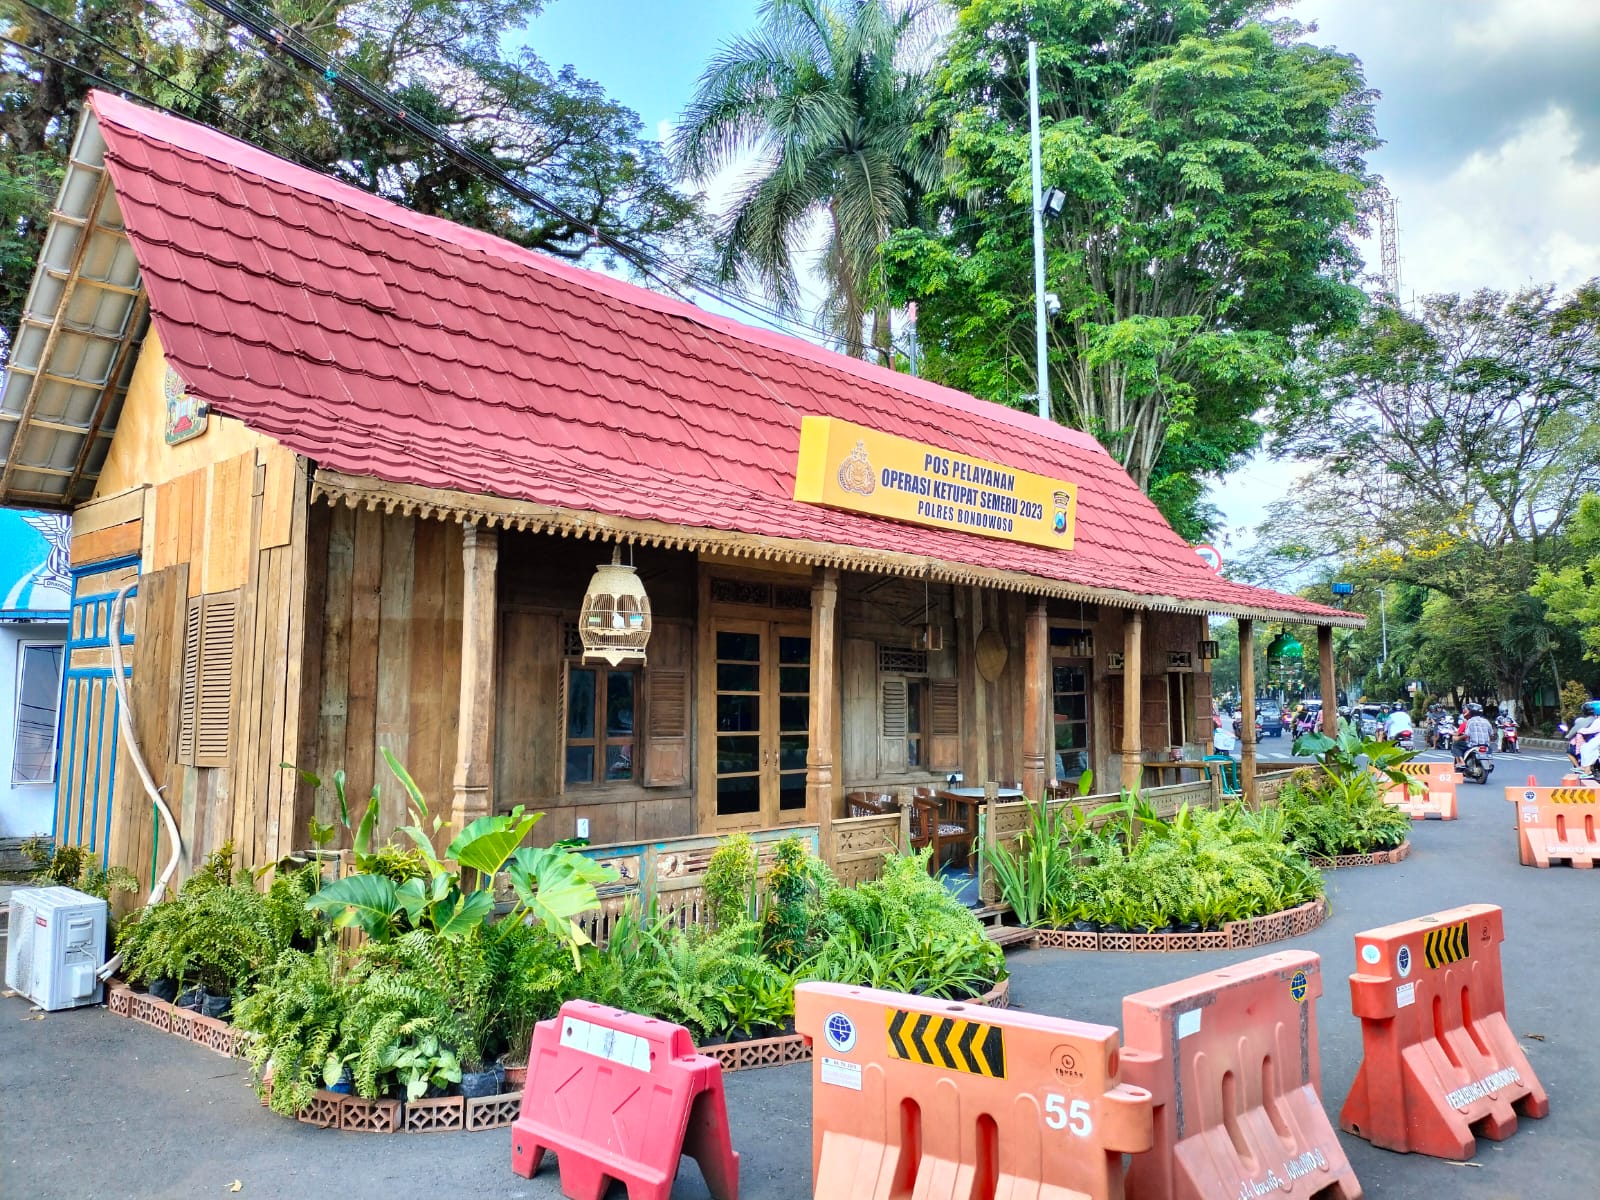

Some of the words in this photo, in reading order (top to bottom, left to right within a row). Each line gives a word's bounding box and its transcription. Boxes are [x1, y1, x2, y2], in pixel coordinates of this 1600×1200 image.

[924, 453, 949, 477] POS
[952, 462, 1015, 491] PELAYANAN
[881, 468, 931, 497] OPERASI
[933, 483, 978, 508] KETUPAT
[980, 491, 1018, 514] SEMERU
[1020, 500, 1043, 520] 2023
[918, 500, 954, 521] POLRES
[957, 510, 1013, 533] BONDOWOSO
[1523, 813, 1539, 823] 51
[1045, 1093, 1092, 1137] 55
